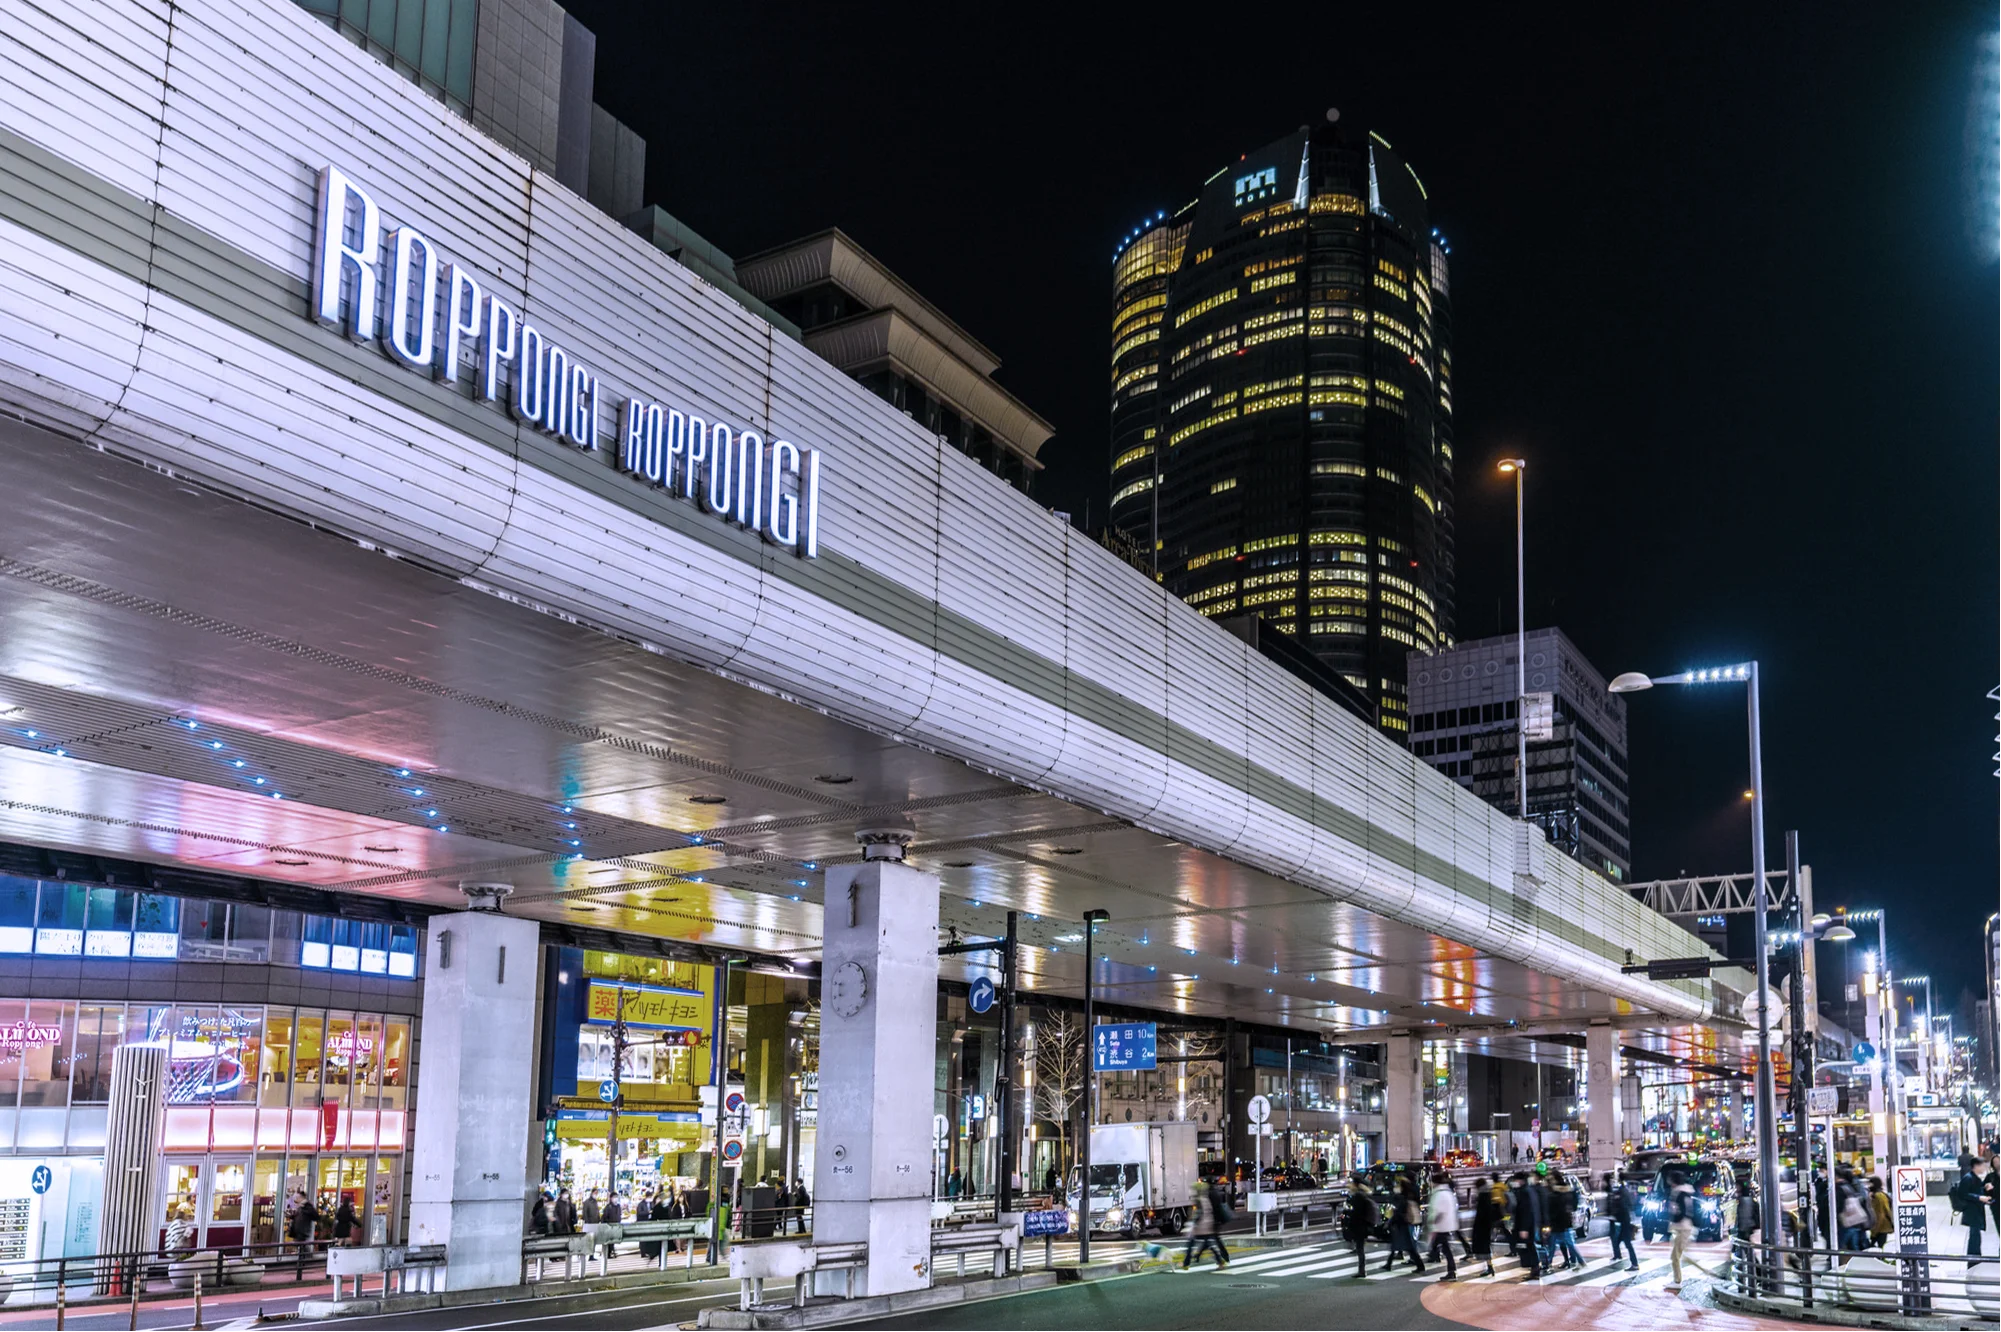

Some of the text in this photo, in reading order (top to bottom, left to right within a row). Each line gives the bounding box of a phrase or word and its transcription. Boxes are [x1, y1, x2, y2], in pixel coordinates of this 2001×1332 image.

[1235, 187, 1276, 207] MORI
[313, 164, 820, 561] ROPPONGI ROPPONGI
[595, 990, 698, 1022] 薬 マツモトキヨシ
[1110, 1049, 1132, 1058] 渋谷
[615, 1121, 655, 1135] ツモトキヨシ
[1899, 1207, 1925, 1216] 交差点内
[1899, 1217, 1912, 1225] では
[1900, 1227, 1926, 1236] タクシーの
[1900, 1236, 1927, 1245] 乗降禁止
